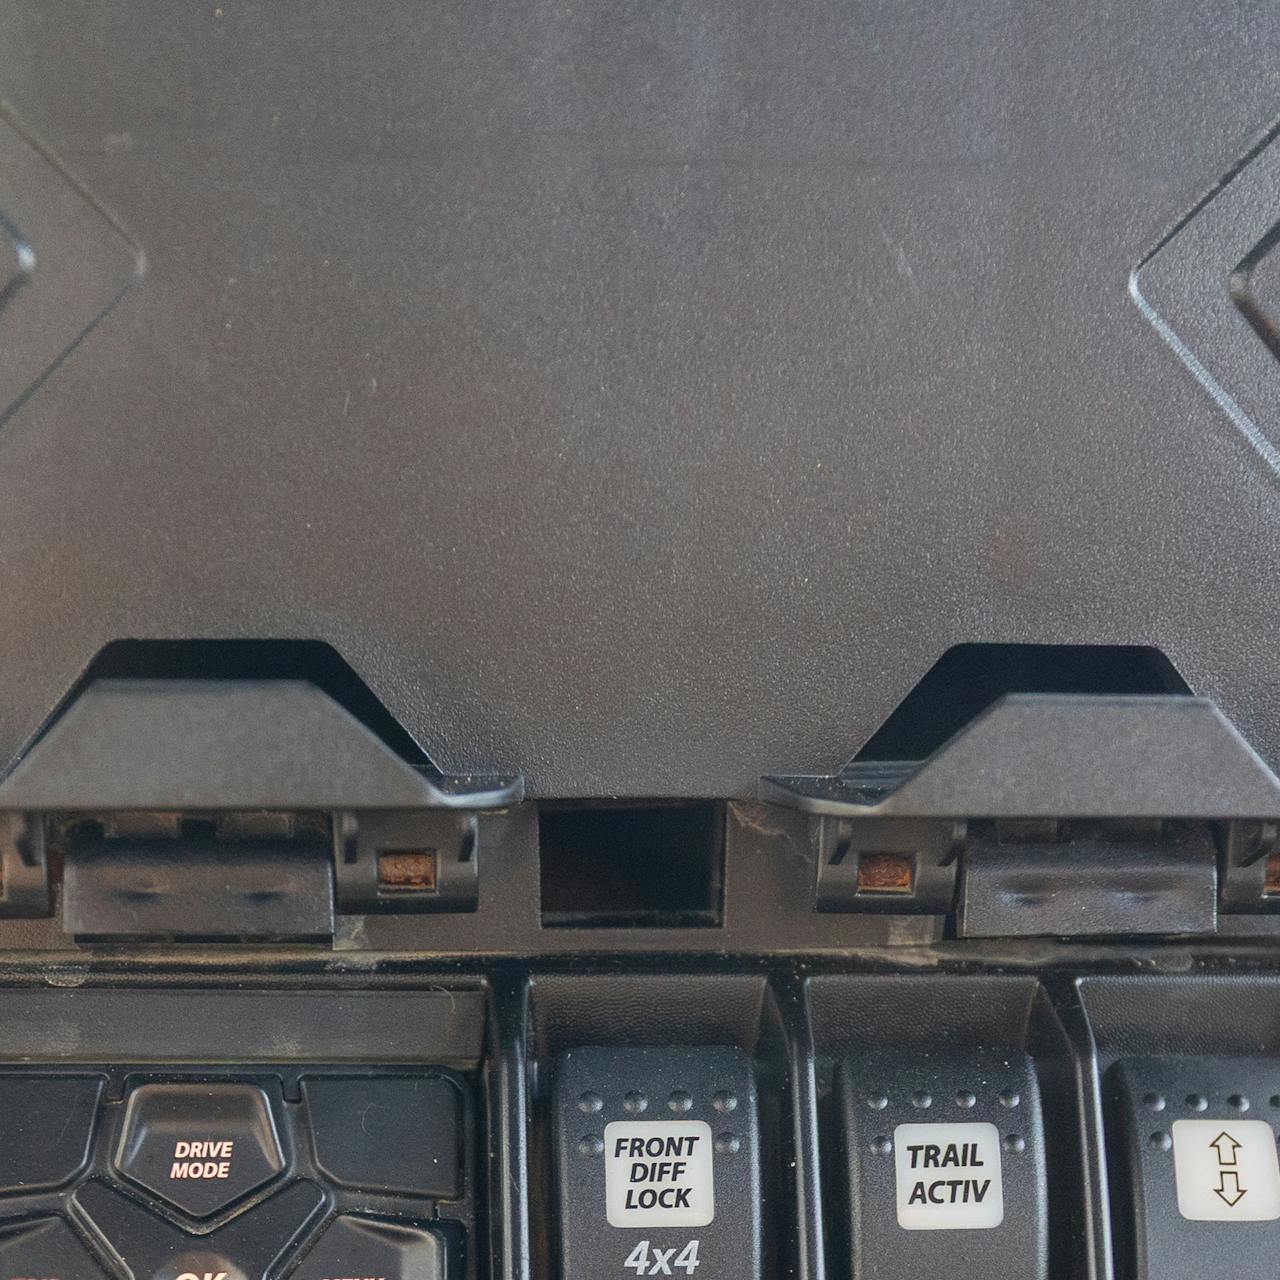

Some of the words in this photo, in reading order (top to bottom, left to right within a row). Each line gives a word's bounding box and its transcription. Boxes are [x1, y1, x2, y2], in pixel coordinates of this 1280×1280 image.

[174, 1141, 233, 1158] DRIVE
[613, 1137, 700, 1159] FRONT
[906, 1144, 984, 1169] TRAIL
[170, 1162, 229, 1178] MODE
[629, 1162, 686, 1184] DIFF
[624, 1186, 693, 1210] LOCK
[908, 1180, 991, 1205] ACTIV
[623, 1240, 701, 1276] 4x4
